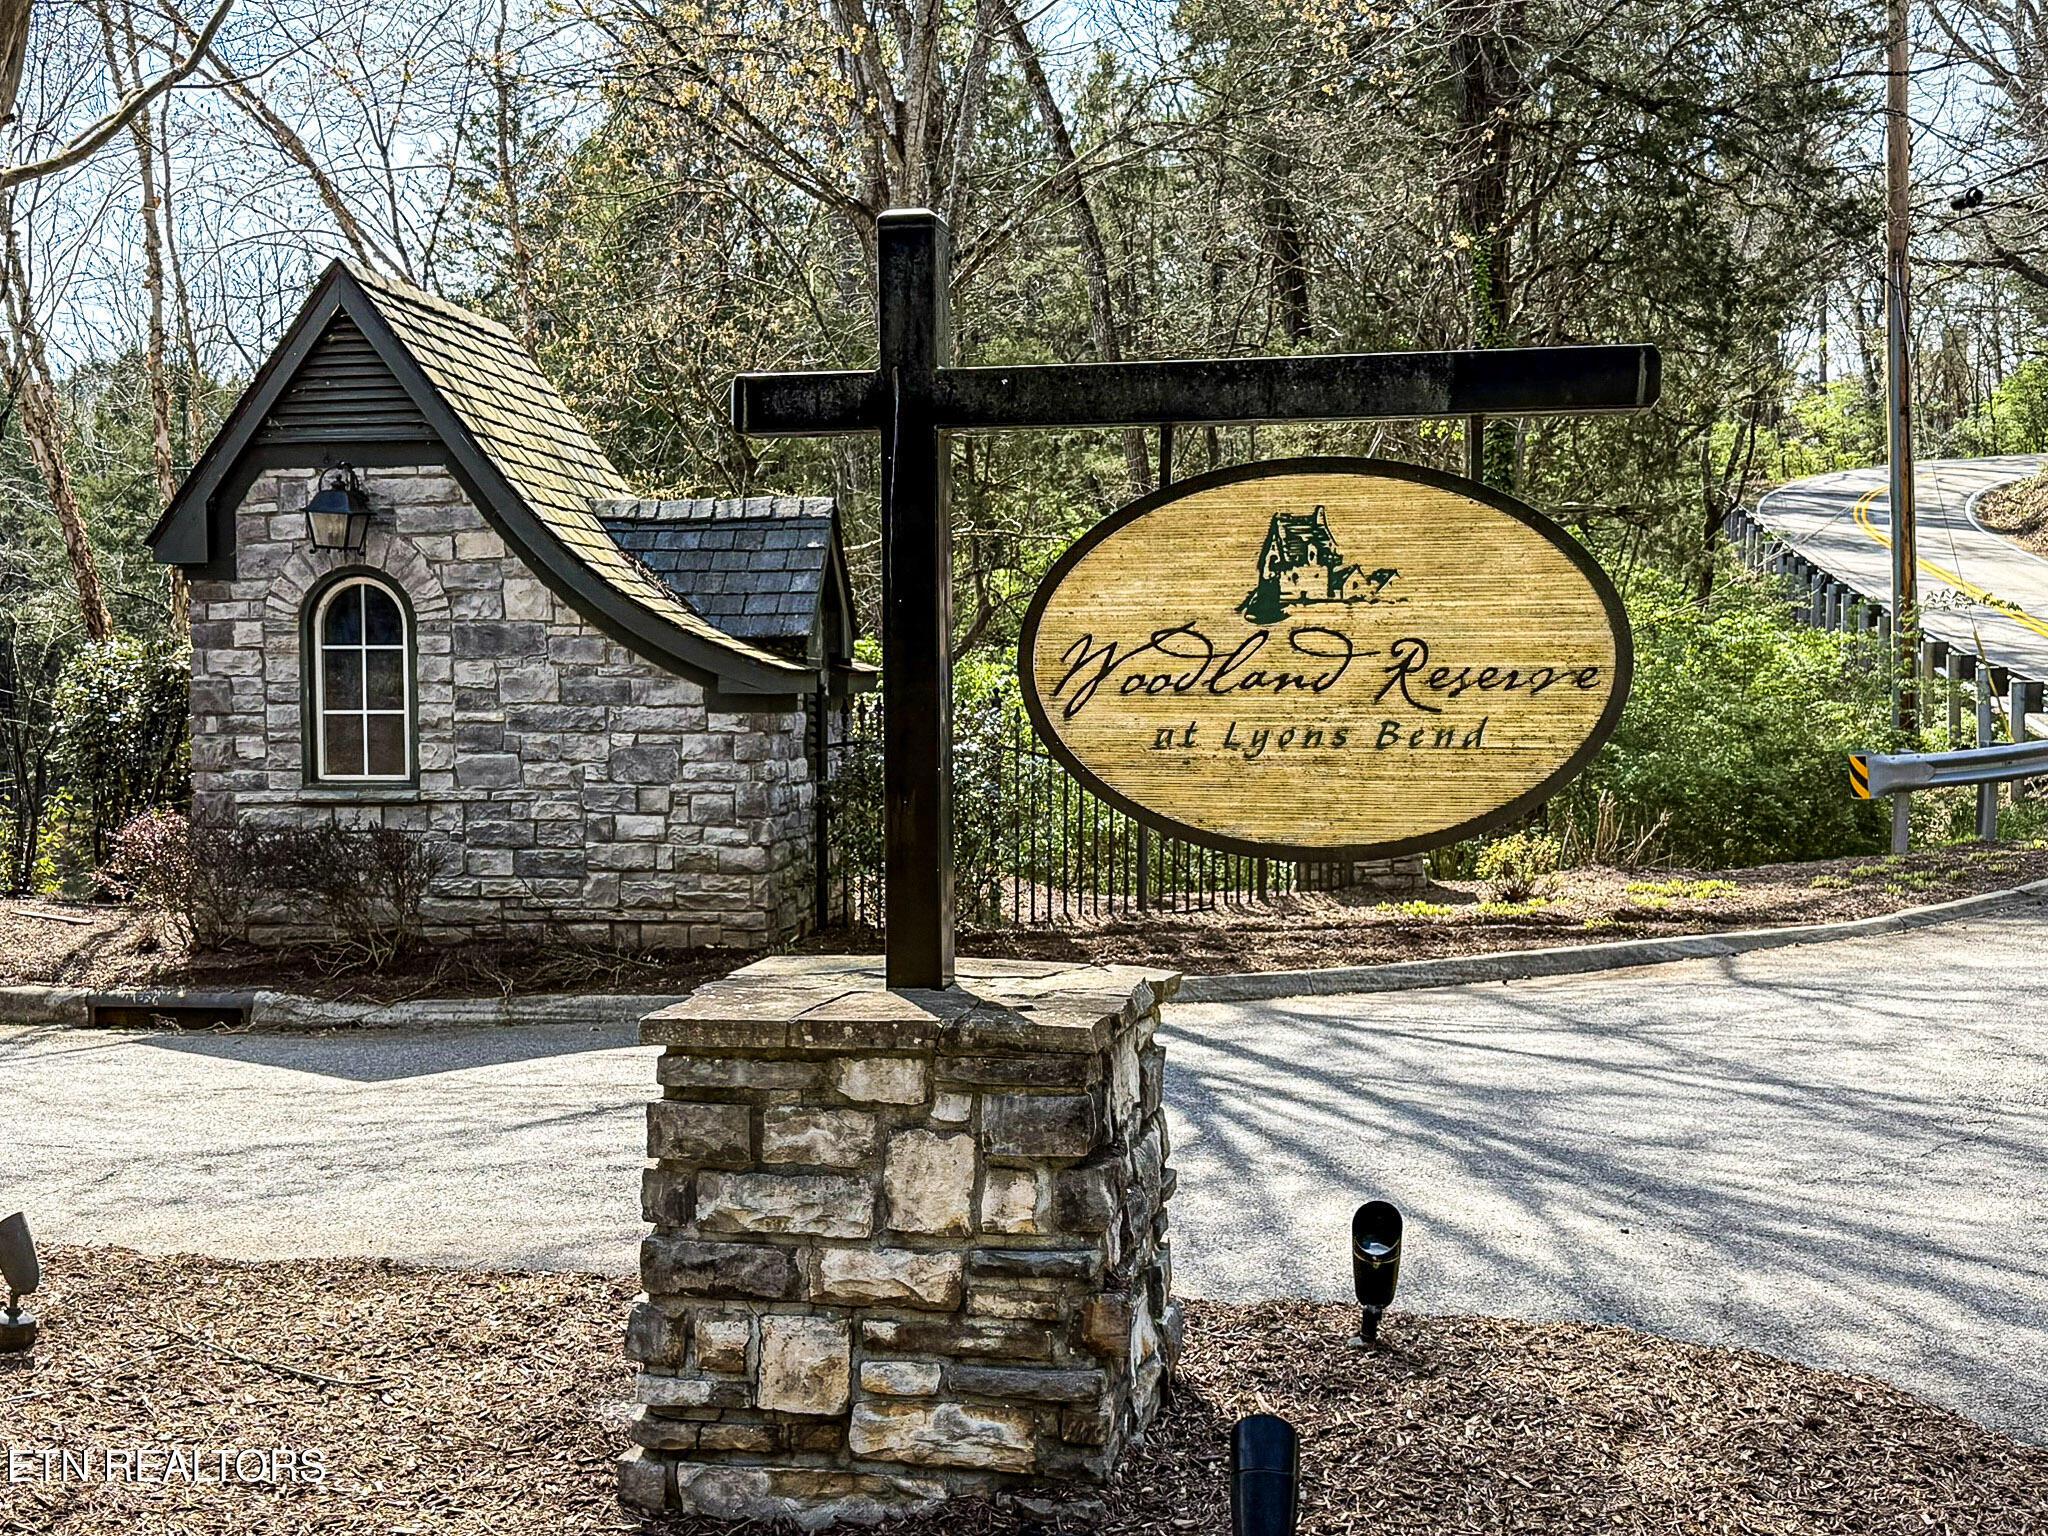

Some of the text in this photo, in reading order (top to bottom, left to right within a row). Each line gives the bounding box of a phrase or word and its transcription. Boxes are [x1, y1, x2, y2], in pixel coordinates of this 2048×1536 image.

[1052, 621, 1600, 718] Woodland Reserve
[1153, 716, 1488, 759] at Lyons Bend
